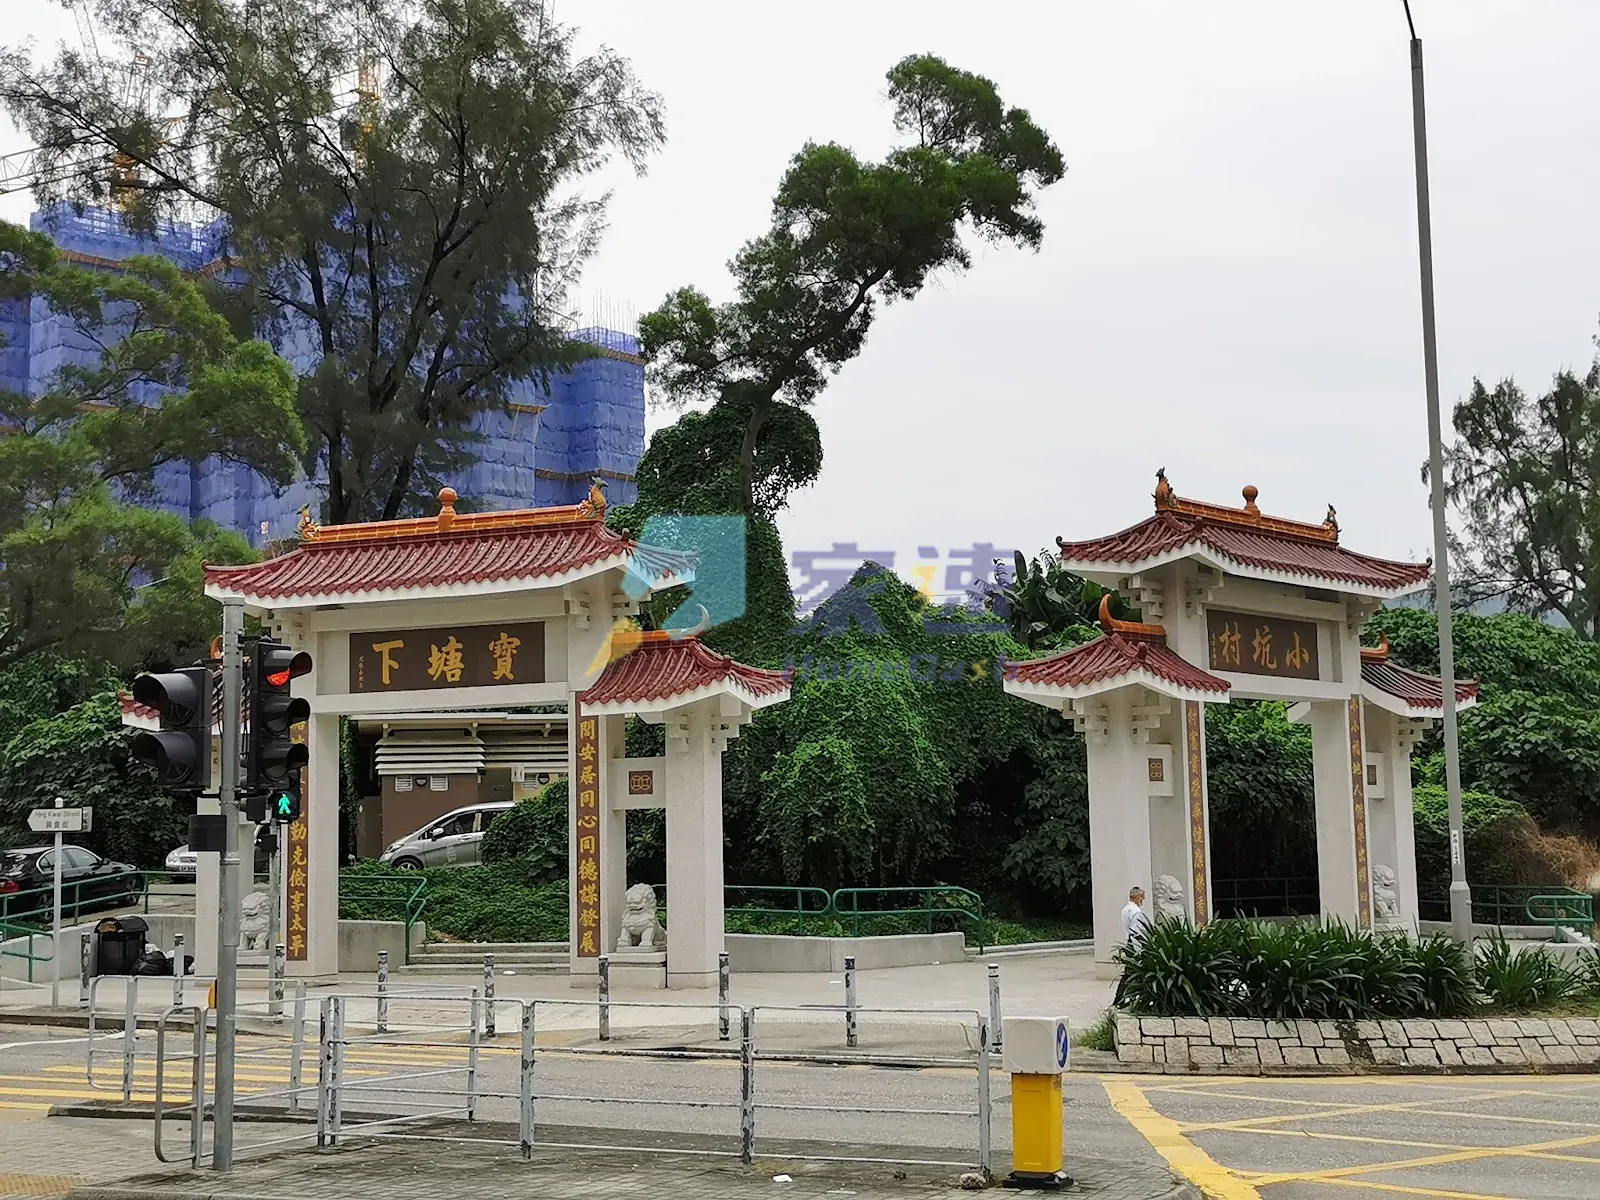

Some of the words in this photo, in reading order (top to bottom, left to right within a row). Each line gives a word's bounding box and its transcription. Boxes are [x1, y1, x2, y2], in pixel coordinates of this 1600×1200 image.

[371, 632, 521, 685] 寶塘下
[1218, 621, 1310, 670] 小坑村
[62, 810, 81, 818] Street
